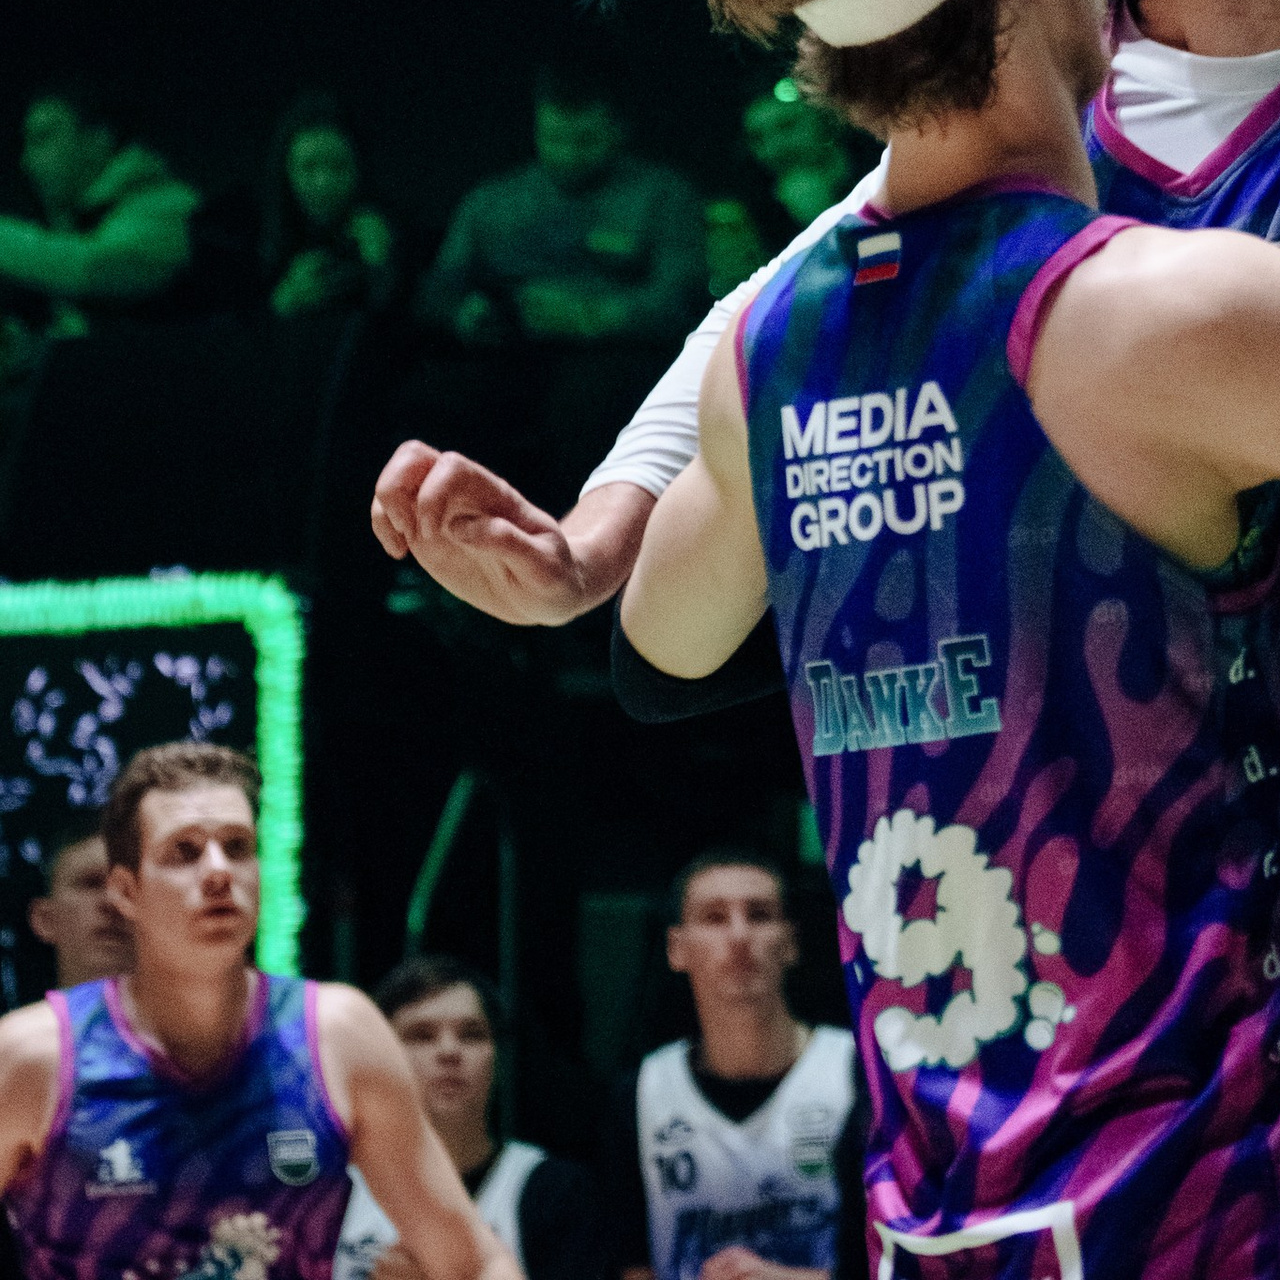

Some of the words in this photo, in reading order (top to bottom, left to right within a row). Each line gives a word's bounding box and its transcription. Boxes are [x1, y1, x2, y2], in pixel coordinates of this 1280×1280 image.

[780, 380, 958, 460] MEDIA
[785, 437, 963, 500] DIRECTION
[790, 478, 966, 552] GROUP
[805, 634, 1003, 757] DANKE
[842, 808, 1028, 1073] 9
